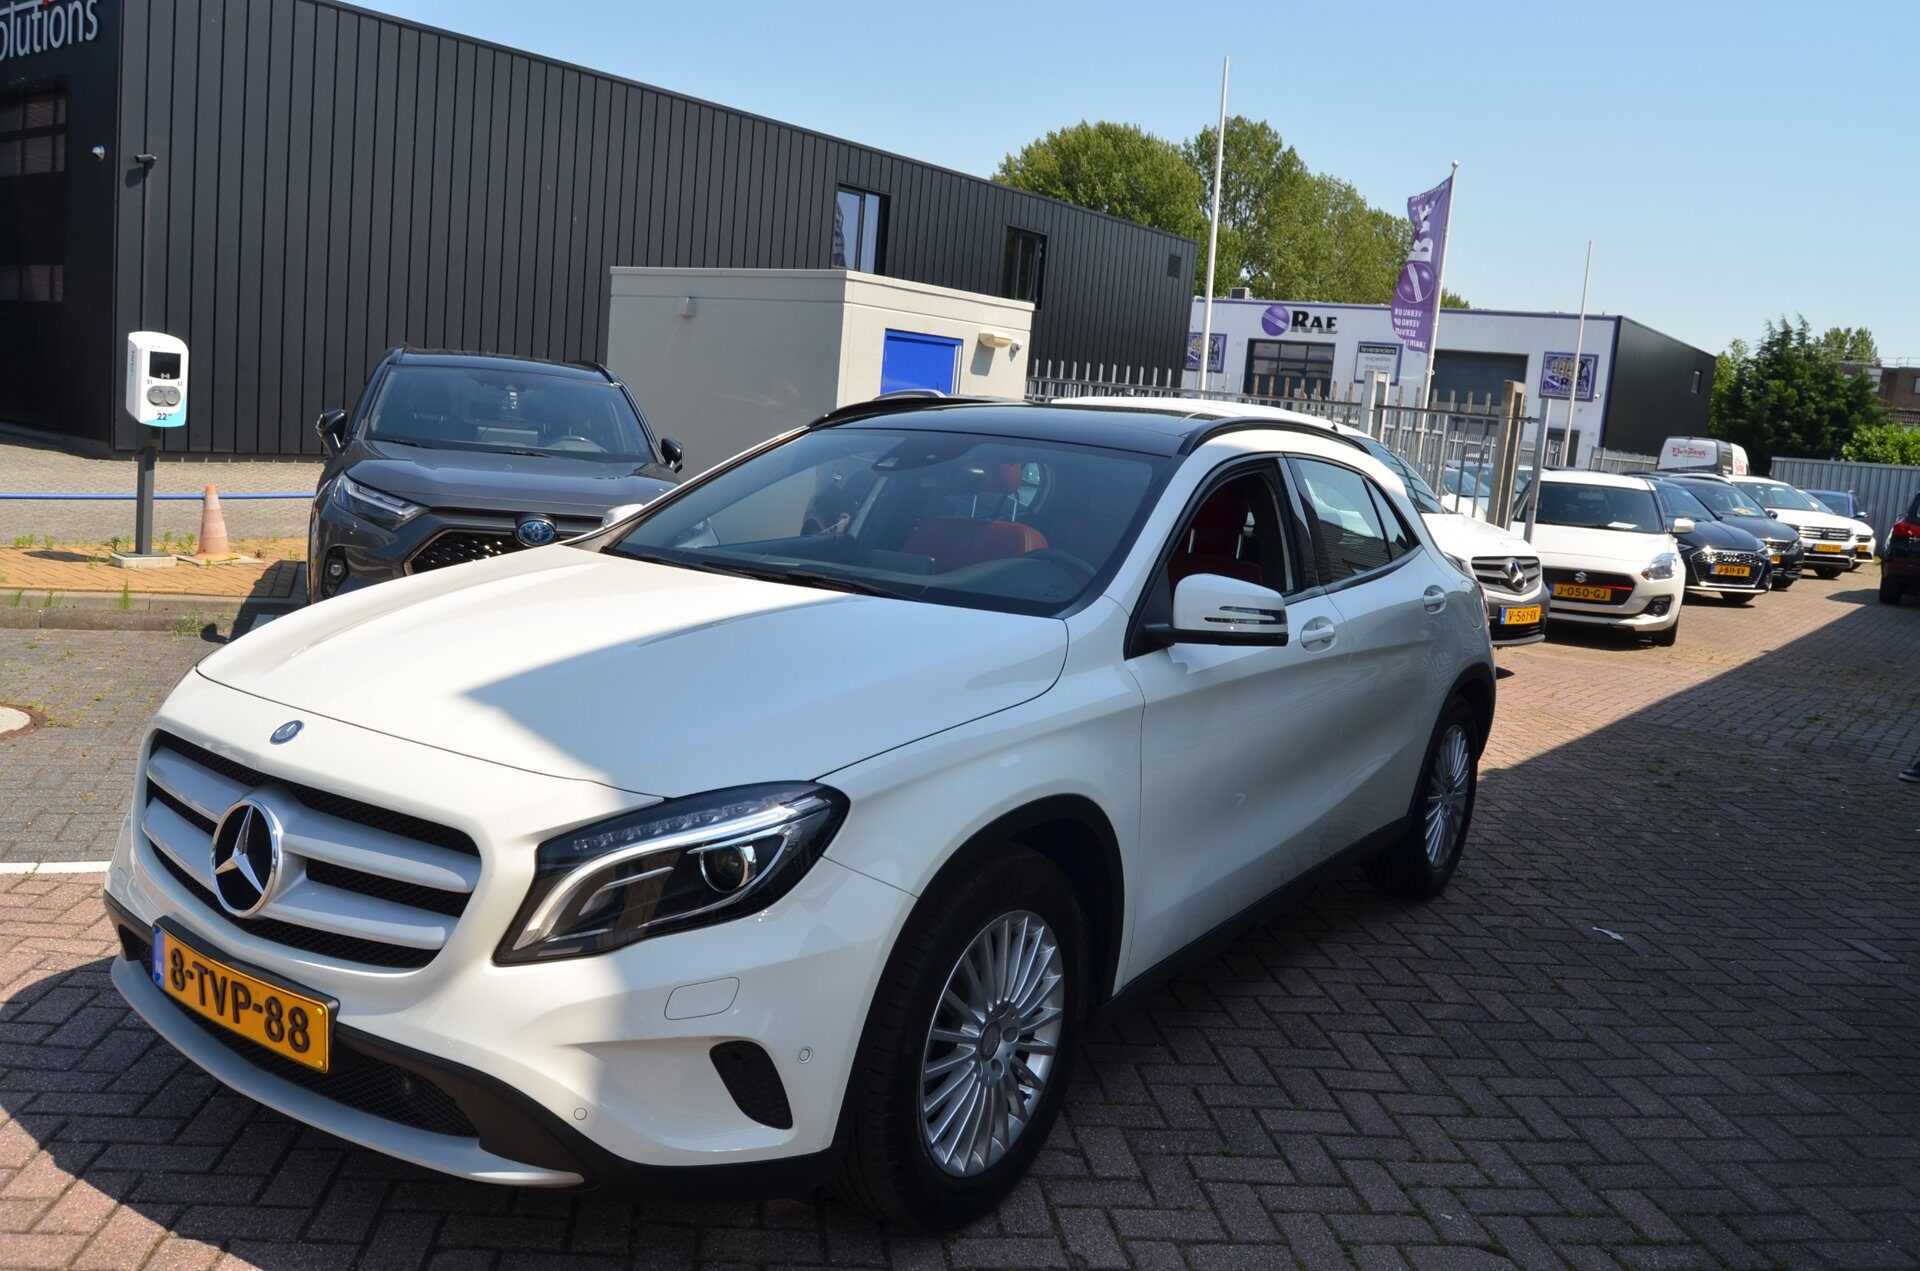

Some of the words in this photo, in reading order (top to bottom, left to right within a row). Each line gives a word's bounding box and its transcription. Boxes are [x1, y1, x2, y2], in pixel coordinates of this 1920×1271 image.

[1291, 310, 1338, 334] RAE
[1557, 586, 1607, 600] J-050-GJ
[170, 947, 310, 1053] 8-TVP-88
